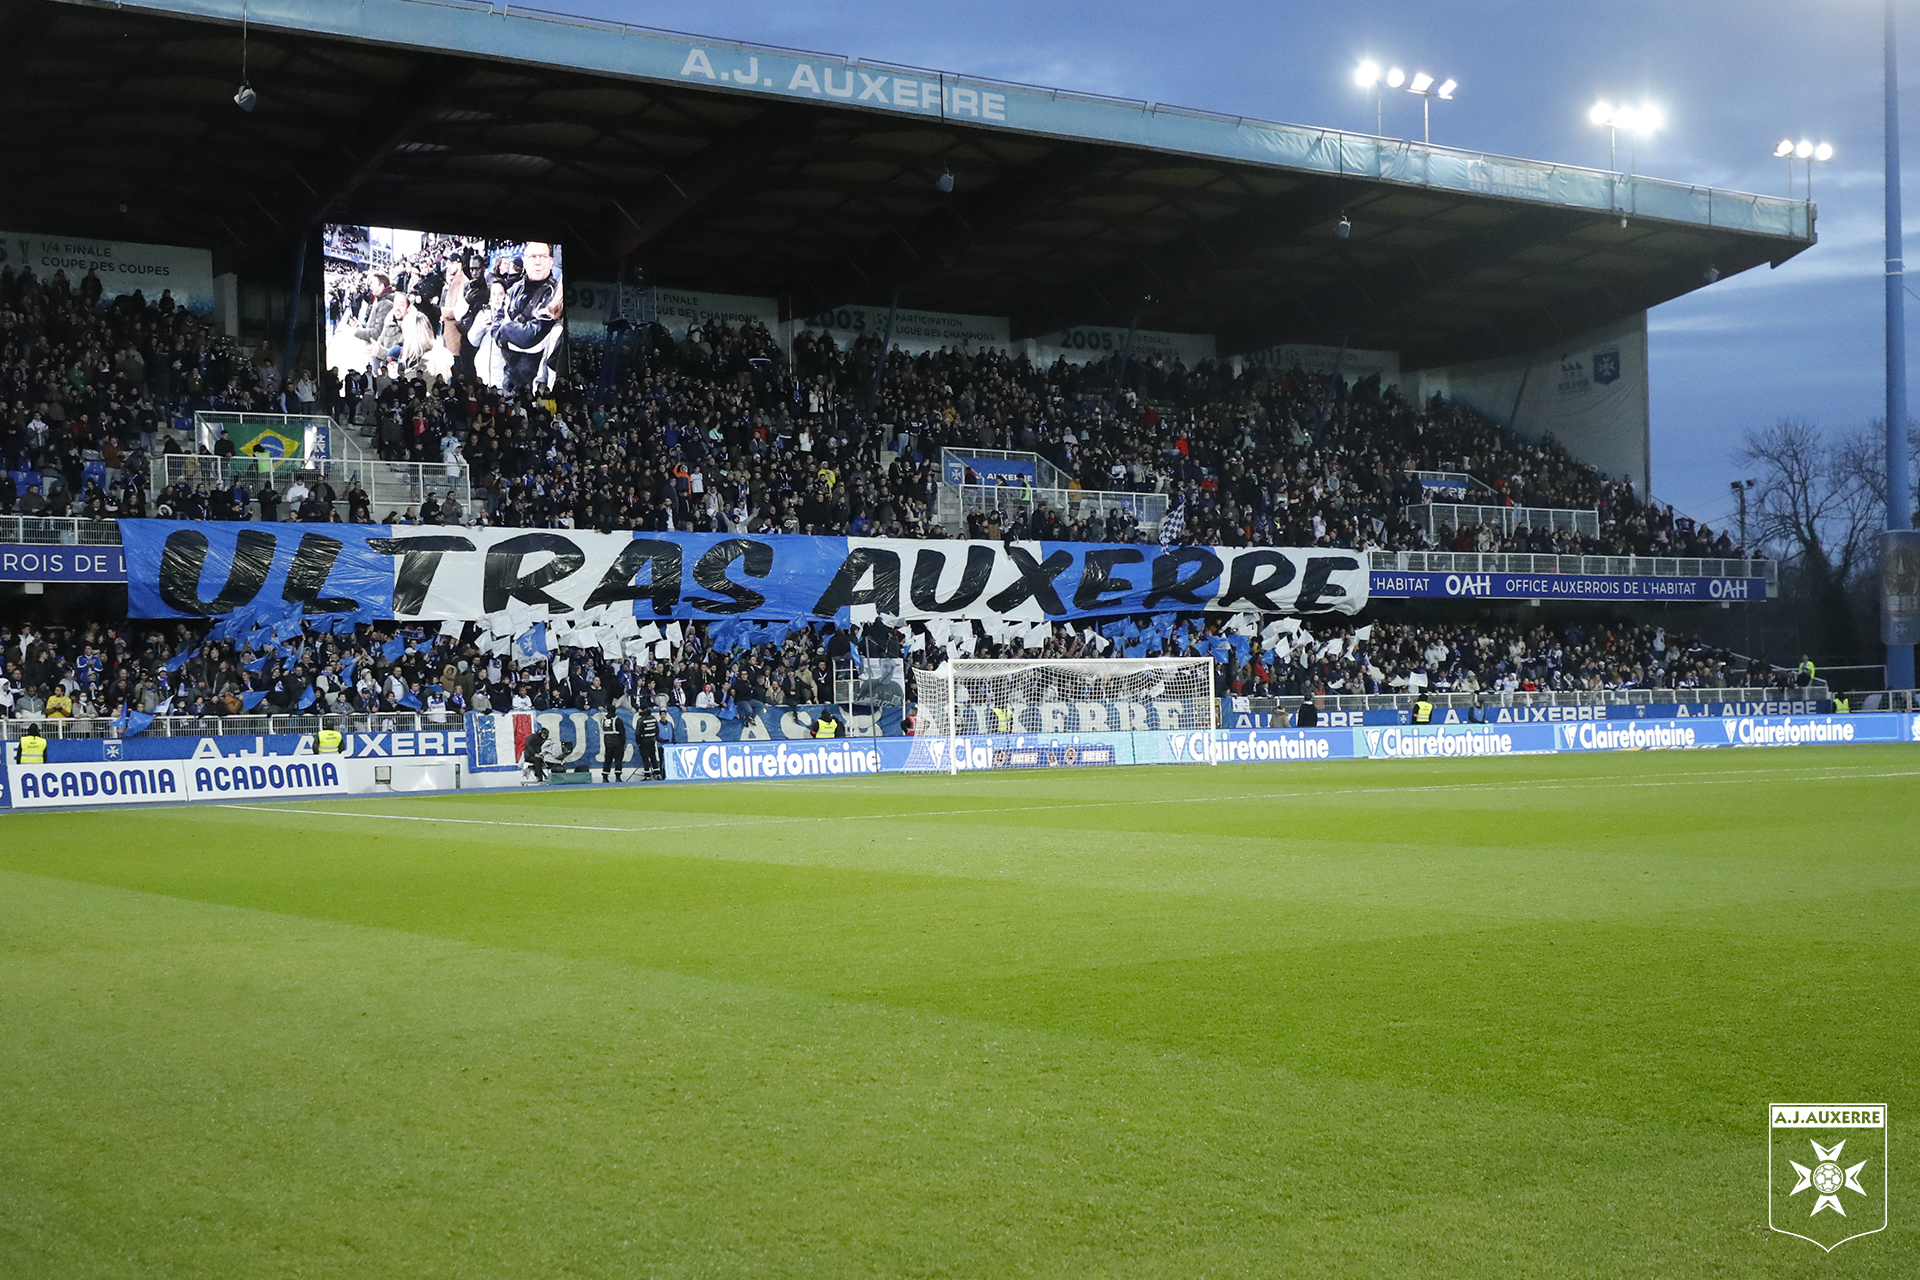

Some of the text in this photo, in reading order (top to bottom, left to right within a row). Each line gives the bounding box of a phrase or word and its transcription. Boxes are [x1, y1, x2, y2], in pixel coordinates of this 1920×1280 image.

[680, 48, 1005, 121] A.J. AUXERRE
[41, 242, 111, 257] 1/4 FINALE
[41, 257, 170, 277] COUPE DES COUPES
[566, 286, 604, 310] 997
[663, 294, 698, 305] FINALE
[678, 308, 697, 318] DES
[700, 311, 759, 323] CHAMPIONS
[806, 309, 866, 331] 2003
[895, 314, 963, 327] PARTICIPATION
[896, 325, 995, 342] LIGUE DES CHAMPIONS
[1061, 329, 1113, 351] 2005
[3, 554, 63, 573] ROIS
[75, 555, 108, 573] DE
[159, 529, 1361, 617] ULTRAS AUXERRE
[1368, 577, 1430, 591] 'HABITAT
[1445, 574, 1491, 596] OAH
[1505, 579, 1697, 595] OFFICE AUXERROIS DE L'HABITAT
[1709, 579, 1748, 599] OAH
[1444, 706, 1607, 724] A.. AUXERRE
[1676, 700, 1817, 718] A.J. AUXERRE
[1579, 720, 1695, 750] Clairefontaine
[1738, 717, 1854, 744] Clairefontaine
[1382, 727, 1512, 756] Clairefontaine
[702, 741, 882, 779] Clairefontaine
[21, 768, 177, 799] ACADOMIA
[195, 762, 339, 792] ACADOMIA
